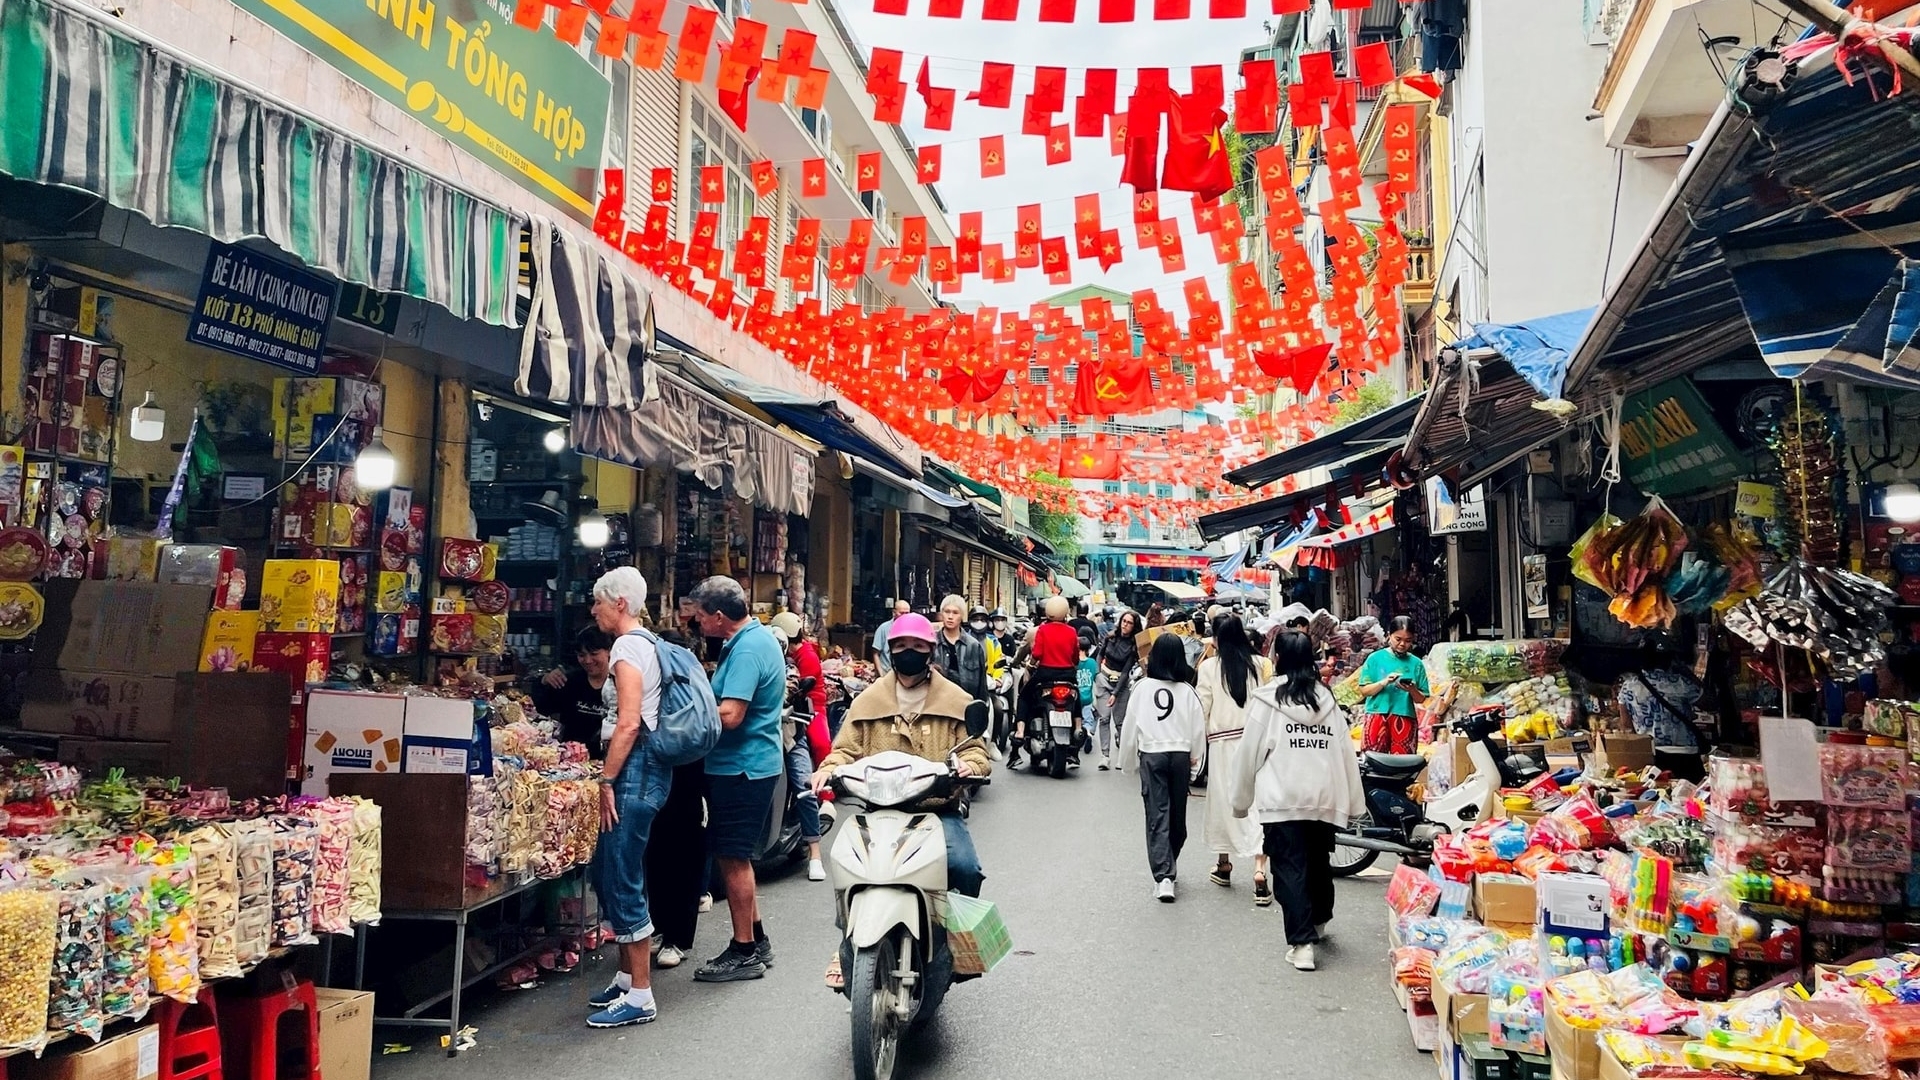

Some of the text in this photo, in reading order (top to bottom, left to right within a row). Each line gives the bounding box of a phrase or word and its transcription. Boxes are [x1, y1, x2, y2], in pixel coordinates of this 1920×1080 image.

[445, 15, 528, 121] TỔNG
[533, 89, 586, 162] HỢP
[211, 251, 233, 286] BÉ
[229, 259, 259, 296] LÂM
[256, 270, 290, 308] (CUNG
[288, 285, 310, 316] KIM
[203, 294, 322, 351] KIỐT 13 PHỐ HÀNG GIẤY
[351, 285, 387, 325] 13
[1441, 522, 1458, 530] NG
[1154, 688, 1174, 721] 9
[1285, 723, 1334, 736] OFFICIAL
